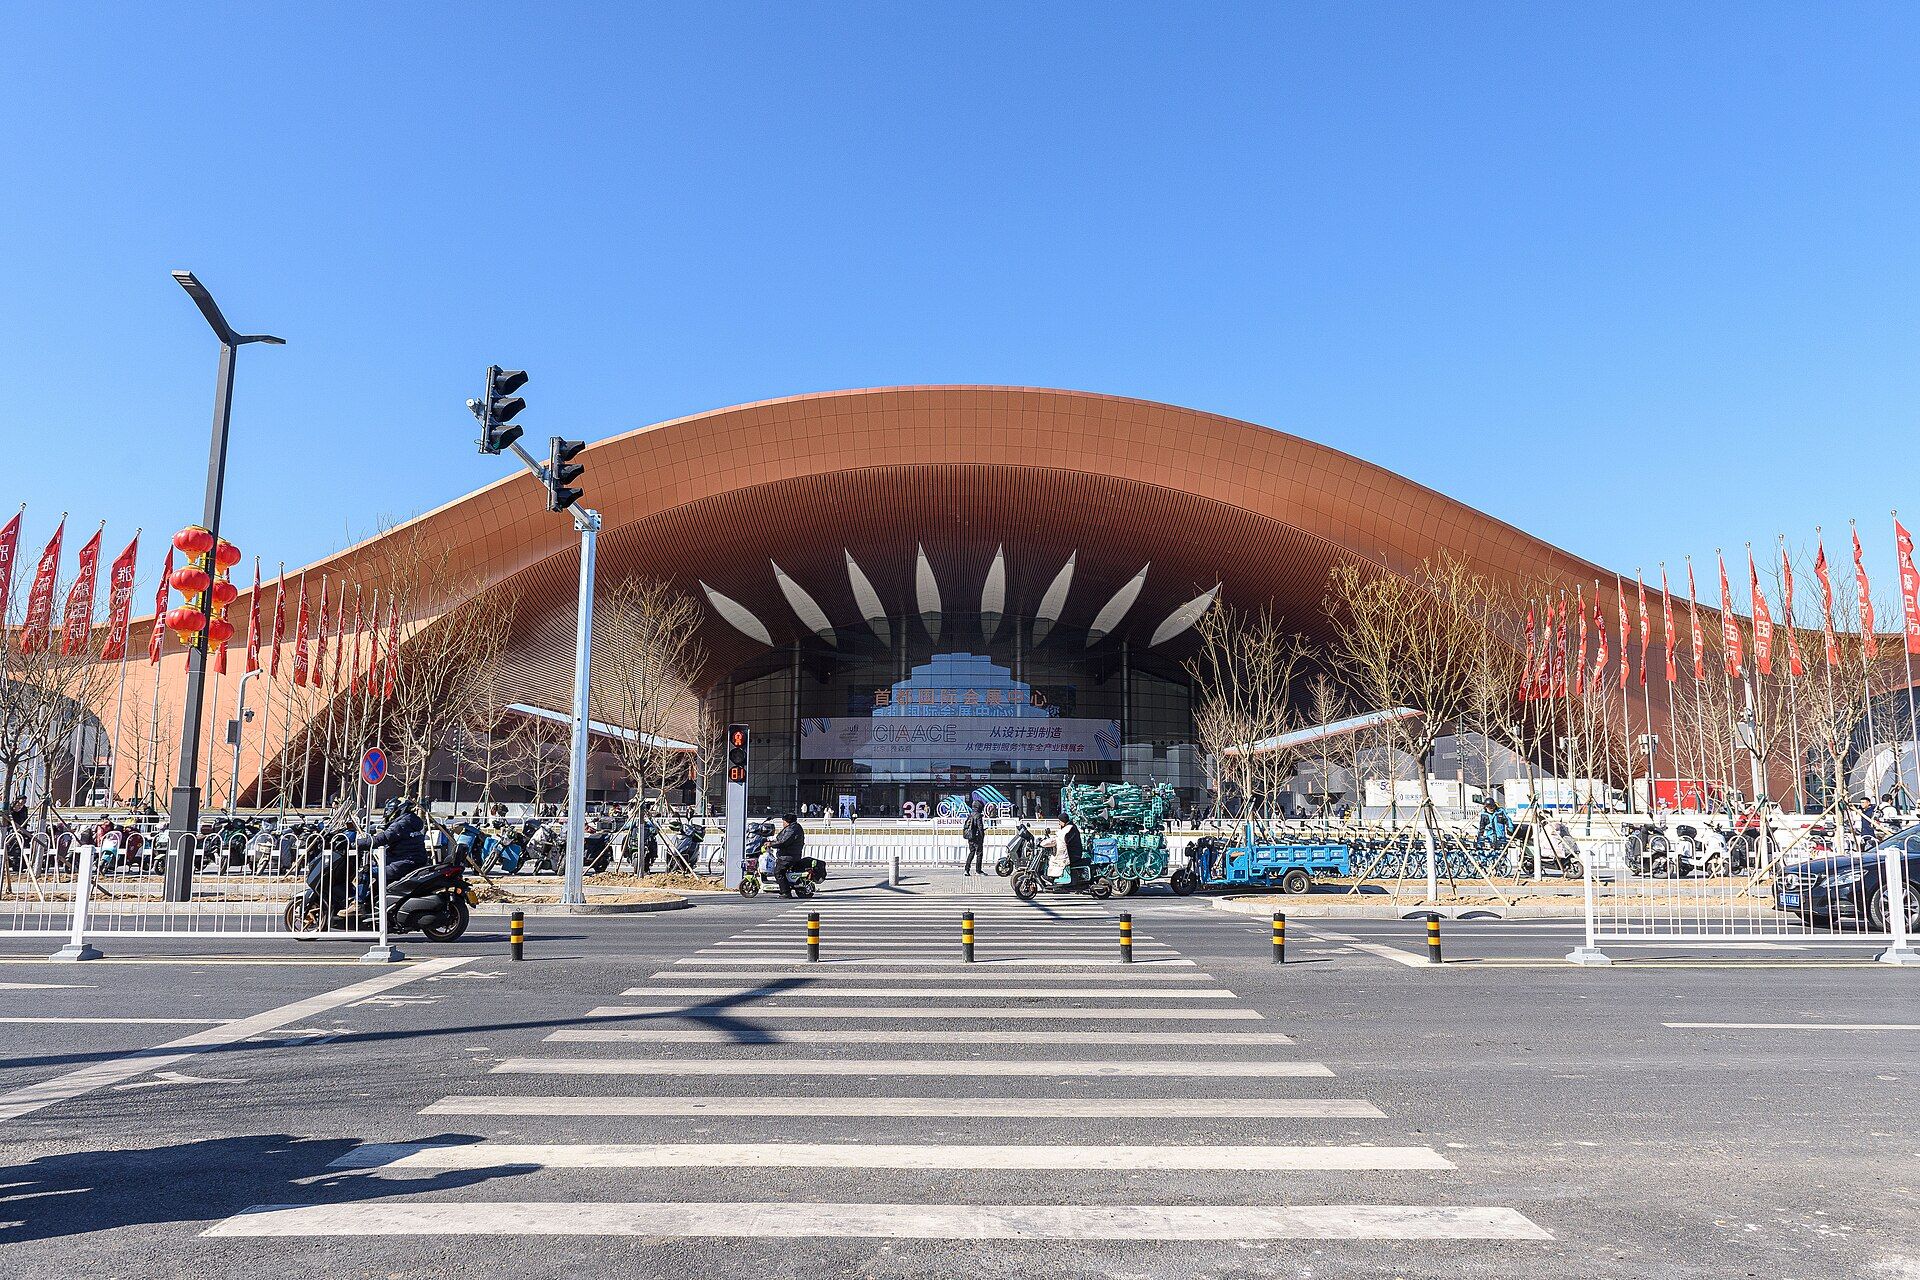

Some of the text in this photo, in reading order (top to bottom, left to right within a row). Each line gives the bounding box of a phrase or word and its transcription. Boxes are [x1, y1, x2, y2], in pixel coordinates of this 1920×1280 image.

[873, 688, 1047, 706] 首都国际会展中心
[873, 724, 957, 743] CIAACE
[989, 726, 1062, 738] 从设计到制造
[965, 742, 1085, 752] 从使用到服务汽车全产业链展会
[731, 768, 744, 780] 81
[902, 801, 1012, 820] 36 CIACE
